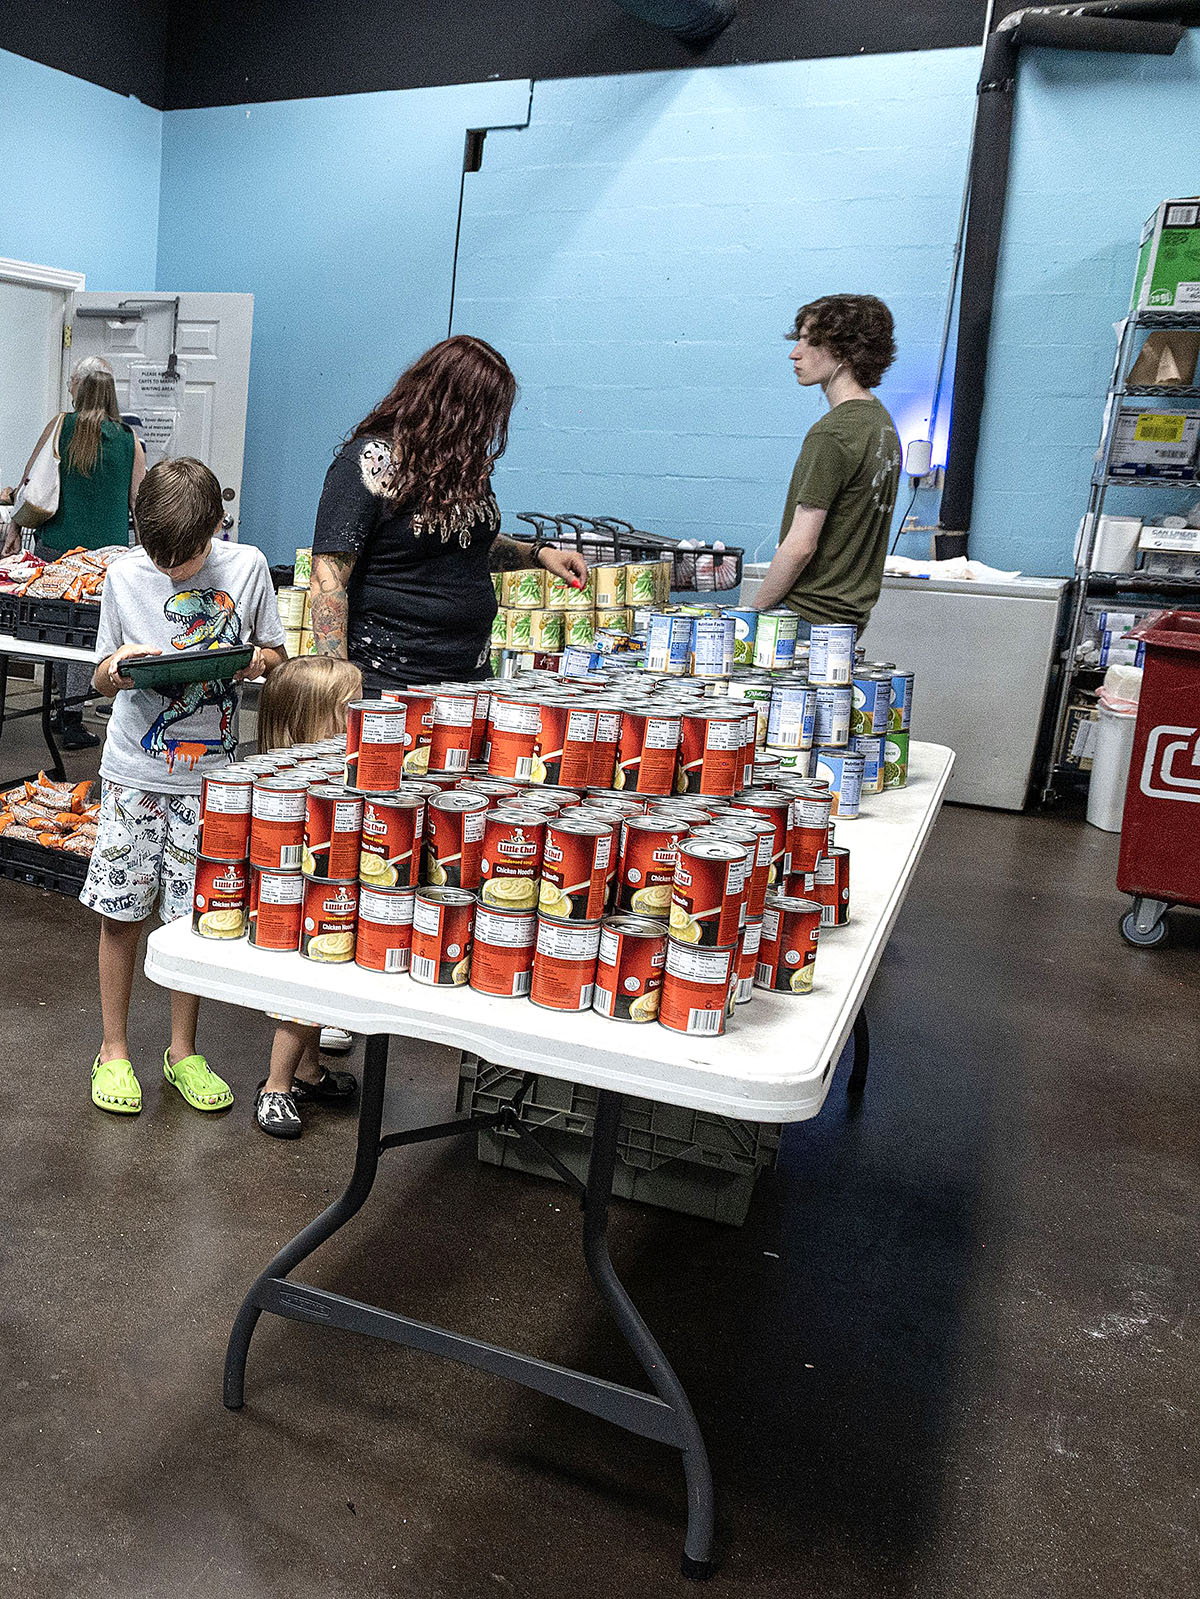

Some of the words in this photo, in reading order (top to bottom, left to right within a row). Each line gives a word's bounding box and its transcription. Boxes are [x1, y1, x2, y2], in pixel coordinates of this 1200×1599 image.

[170, 800, 196, 824] UPER
[500, 844, 519, 853] Little
[520, 846, 536, 854] Chef
[655, 852, 674, 860] Little
[496, 866, 517, 874] Chicken
[651, 874, 671, 882] Chicken
[344, 902, 356, 910] Chef
